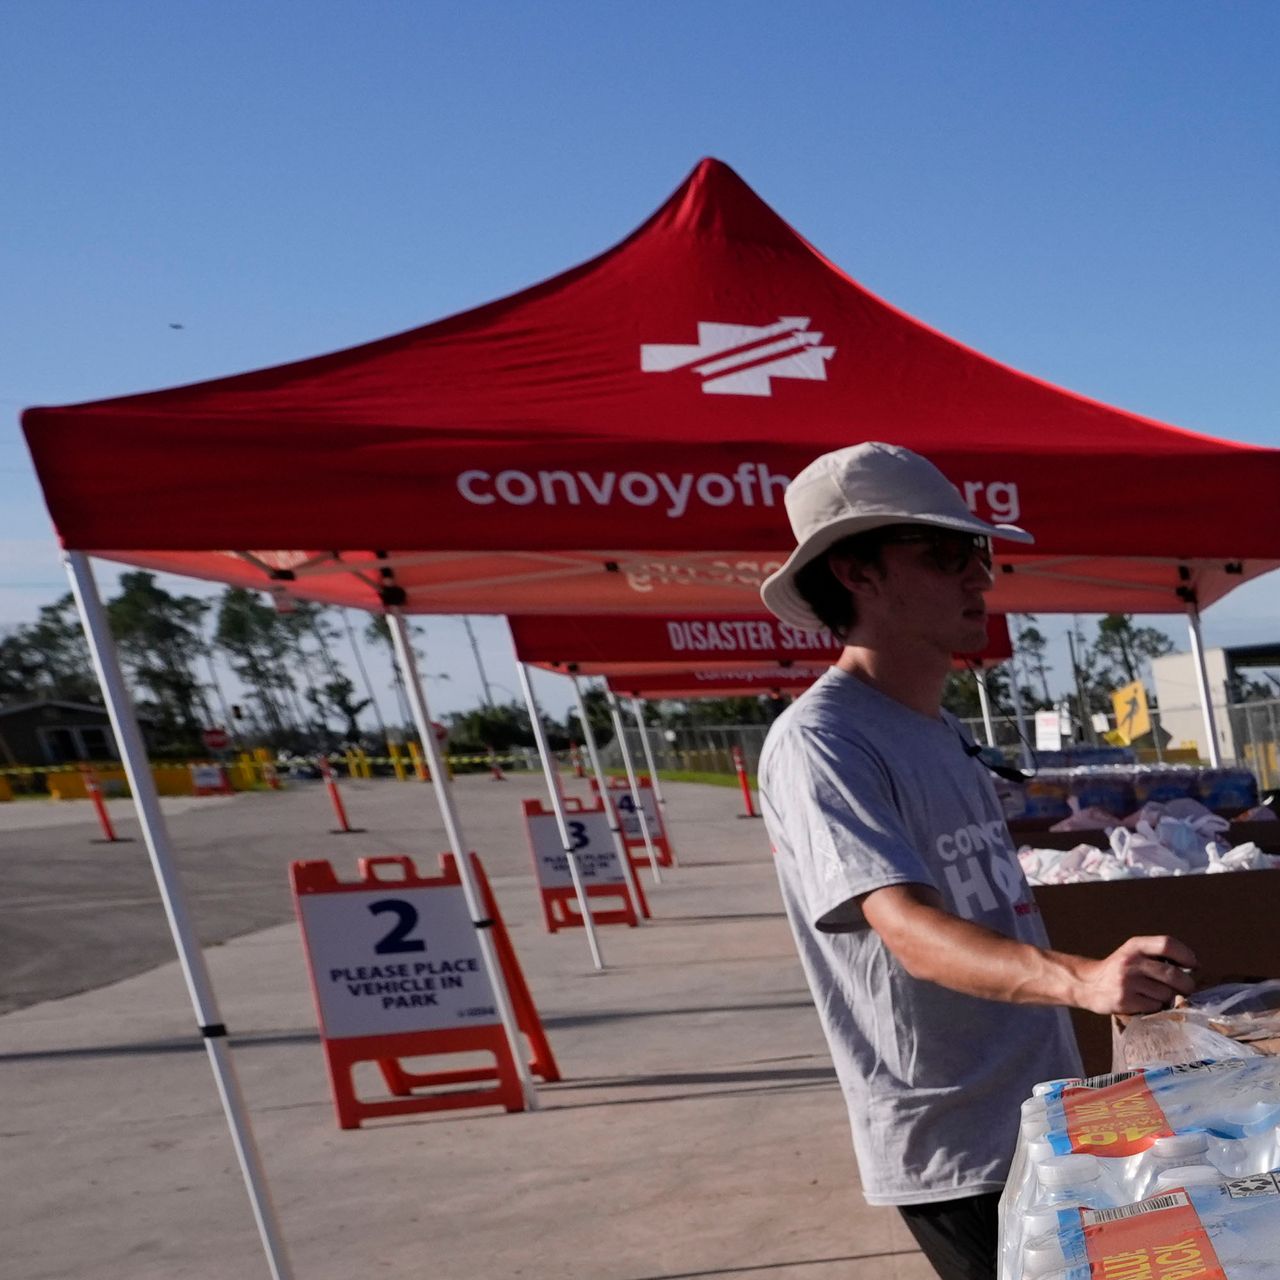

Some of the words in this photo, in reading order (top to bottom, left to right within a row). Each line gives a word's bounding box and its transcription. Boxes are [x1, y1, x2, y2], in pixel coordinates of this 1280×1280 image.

[457, 463, 1020, 522] convoyofhrg
[666, 621, 775, 650] DISASTER
[778, 622, 846, 649] SERV
[619, 796, 636, 813] 4
[568, 822, 589, 849] 3
[944, 852, 1022, 919] HO
[368, 898, 427, 956] 2
[330, 964, 409, 983] PLEASE
[414, 958, 479, 976] PLACE
[347, 977, 435, 997] VEHICLE
[440, 975, 463, 990] IN
[382, 993, 439, 1010] PARK
